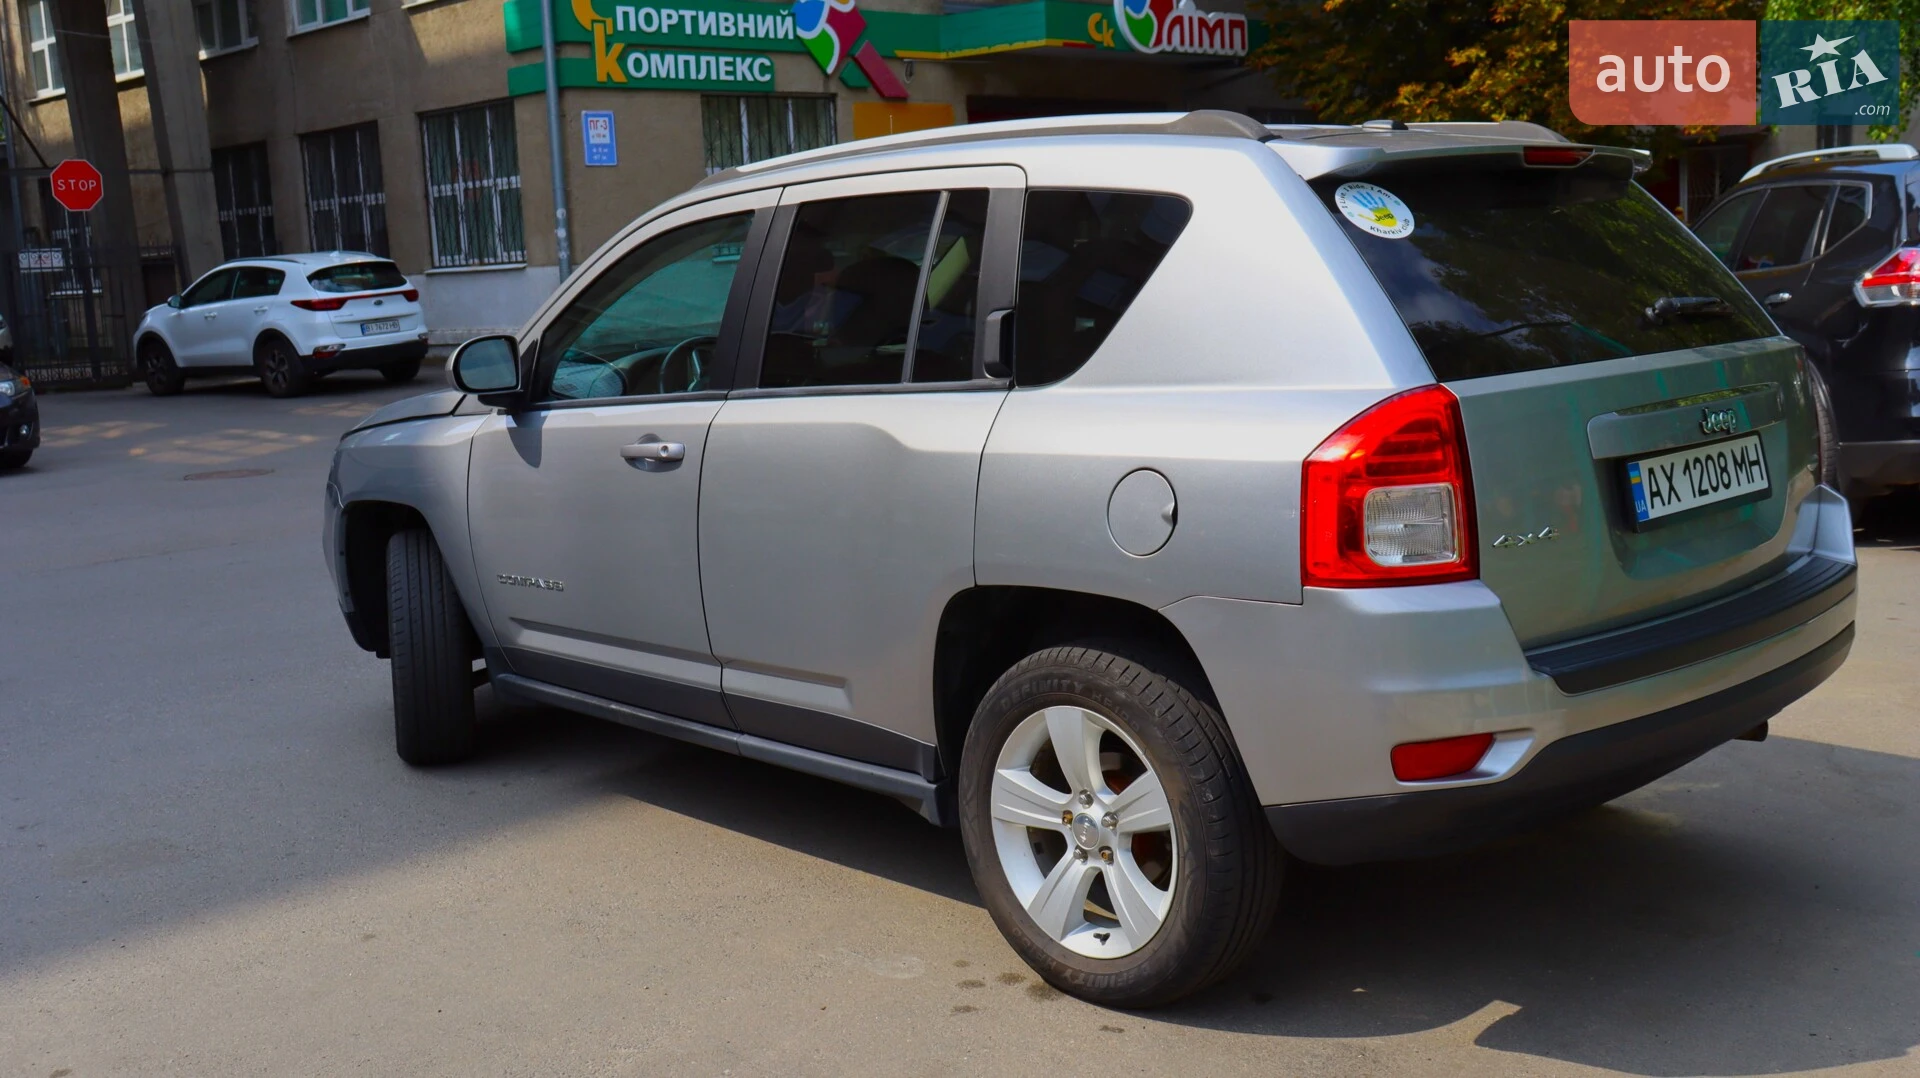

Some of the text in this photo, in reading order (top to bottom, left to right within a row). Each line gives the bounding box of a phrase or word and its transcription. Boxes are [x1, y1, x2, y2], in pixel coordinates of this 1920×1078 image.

[593, 22, 772, 82] КОМПЛЕКС
[57, 179, 97, 191] STOP
[1375, 213, 1394, 221] Jeep
[1700, 407, 1737, 434] Jeep
[1647, 444, 1764, 509] AX 1208 MH
[1635, 500, 1648, 513] UA
